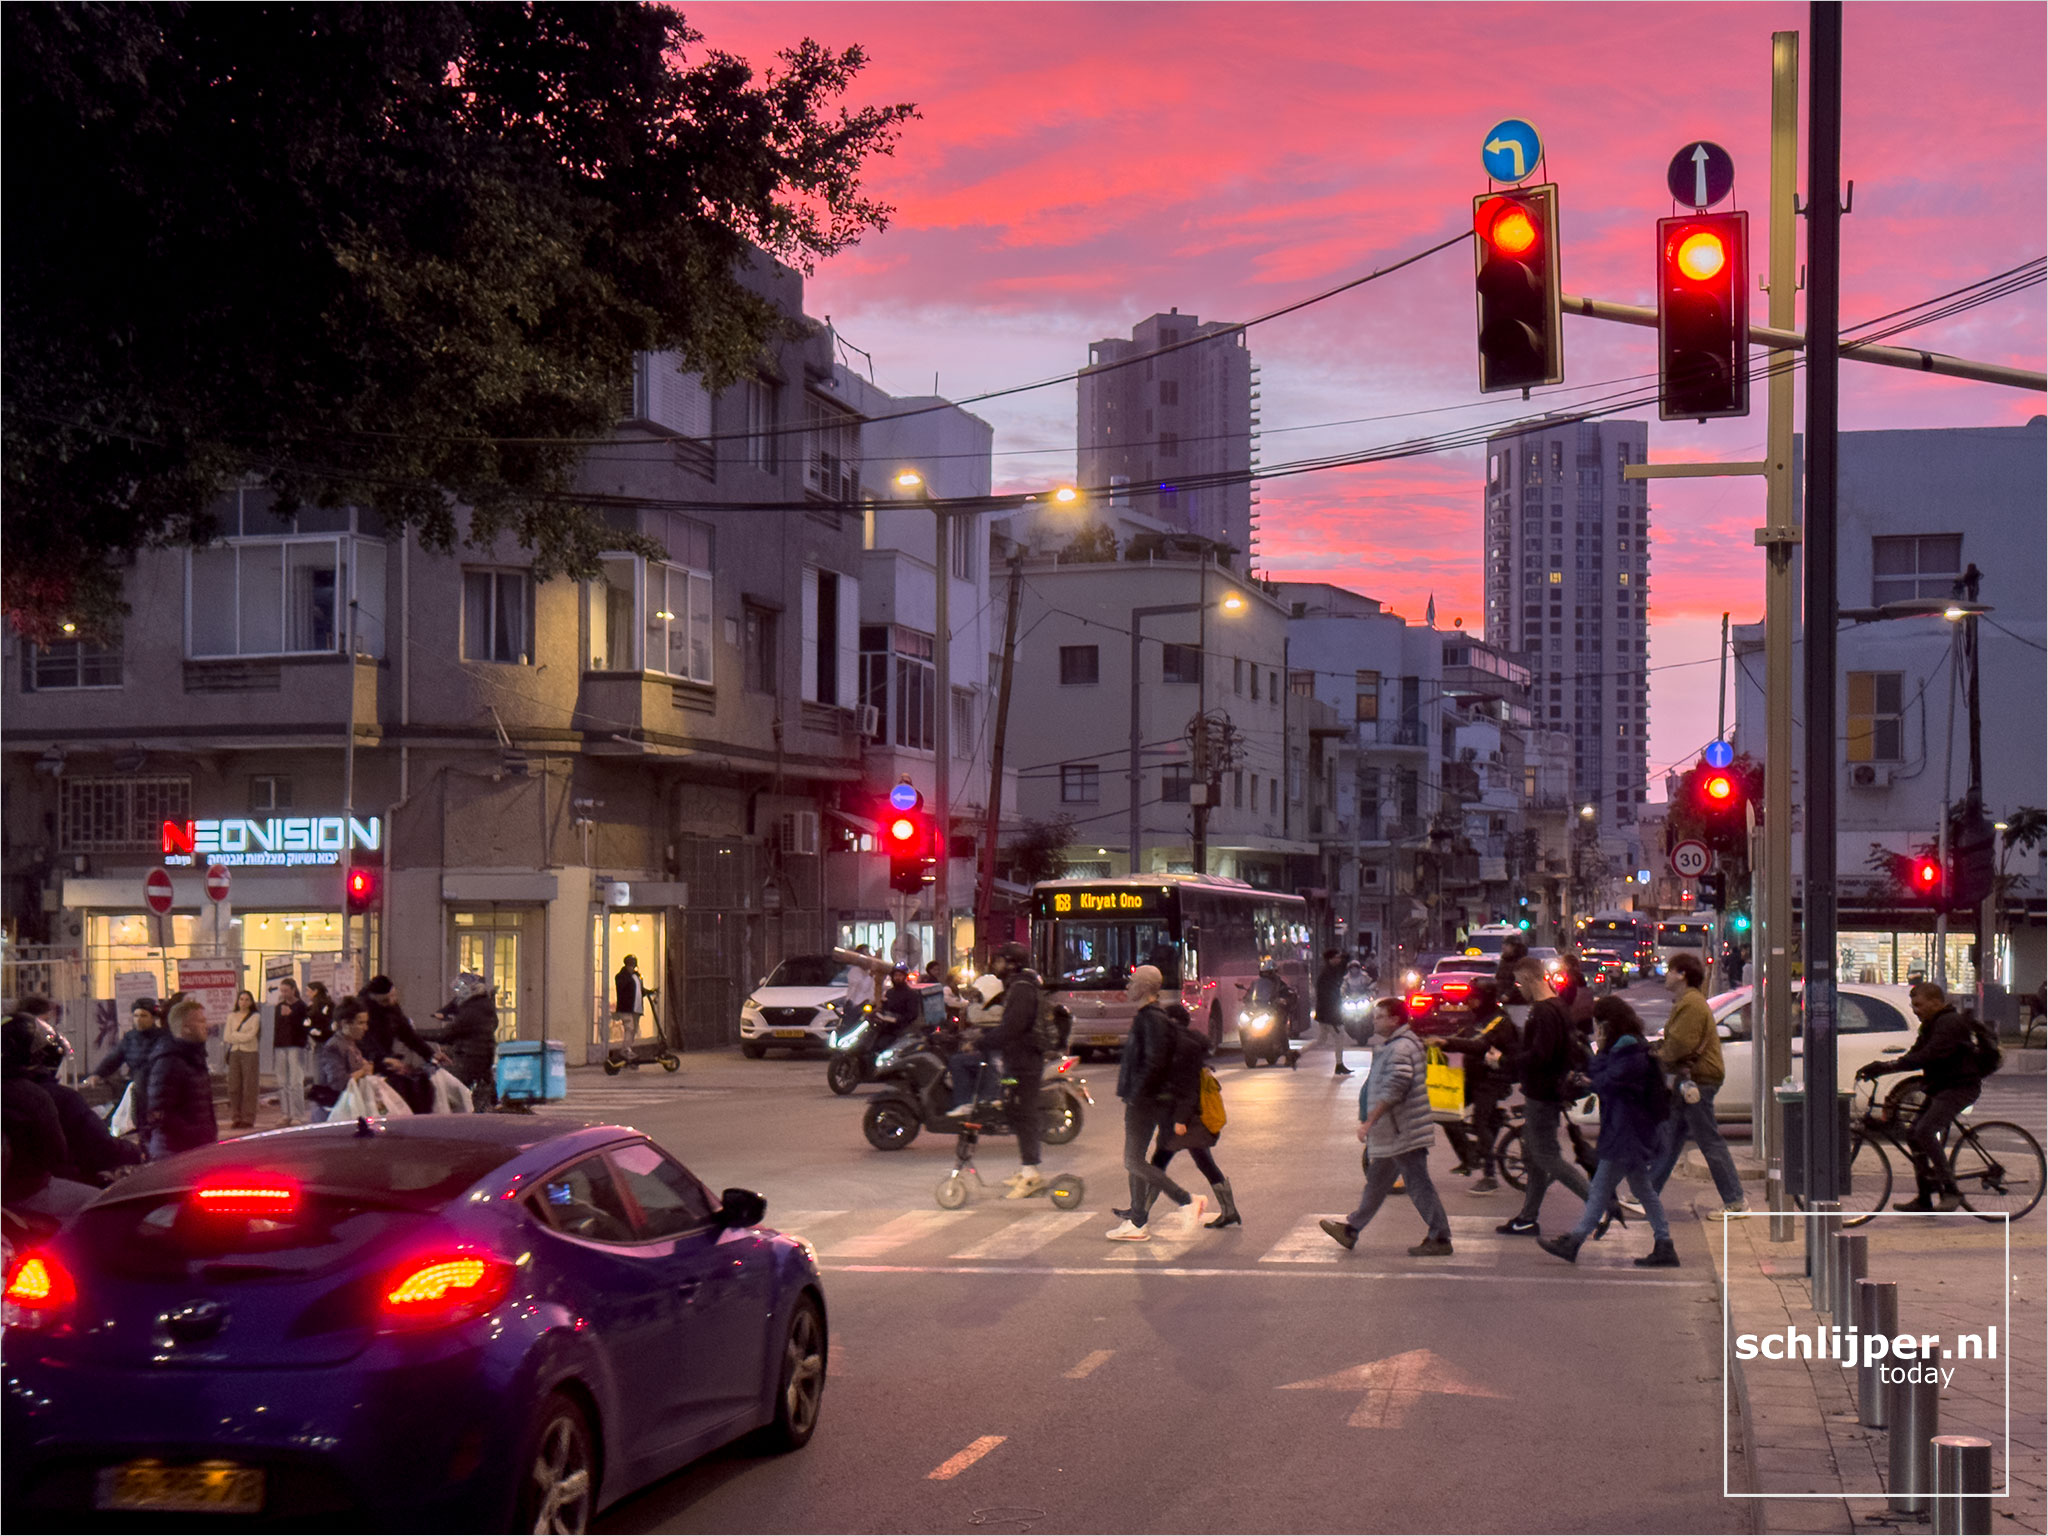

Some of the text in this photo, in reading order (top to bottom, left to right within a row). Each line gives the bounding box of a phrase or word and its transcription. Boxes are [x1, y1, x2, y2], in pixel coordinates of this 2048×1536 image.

[163, 817, 380, 852] NEOVISION
[207, 852, 245, 866] אבטחה
[245, 850, 286, 866] מצלמות
[317, 852, 339, 865] יבוא
[1680, 852, 1702, 867] 30
[1054, 892, 1142, 911] 168 Kiryat Ono
